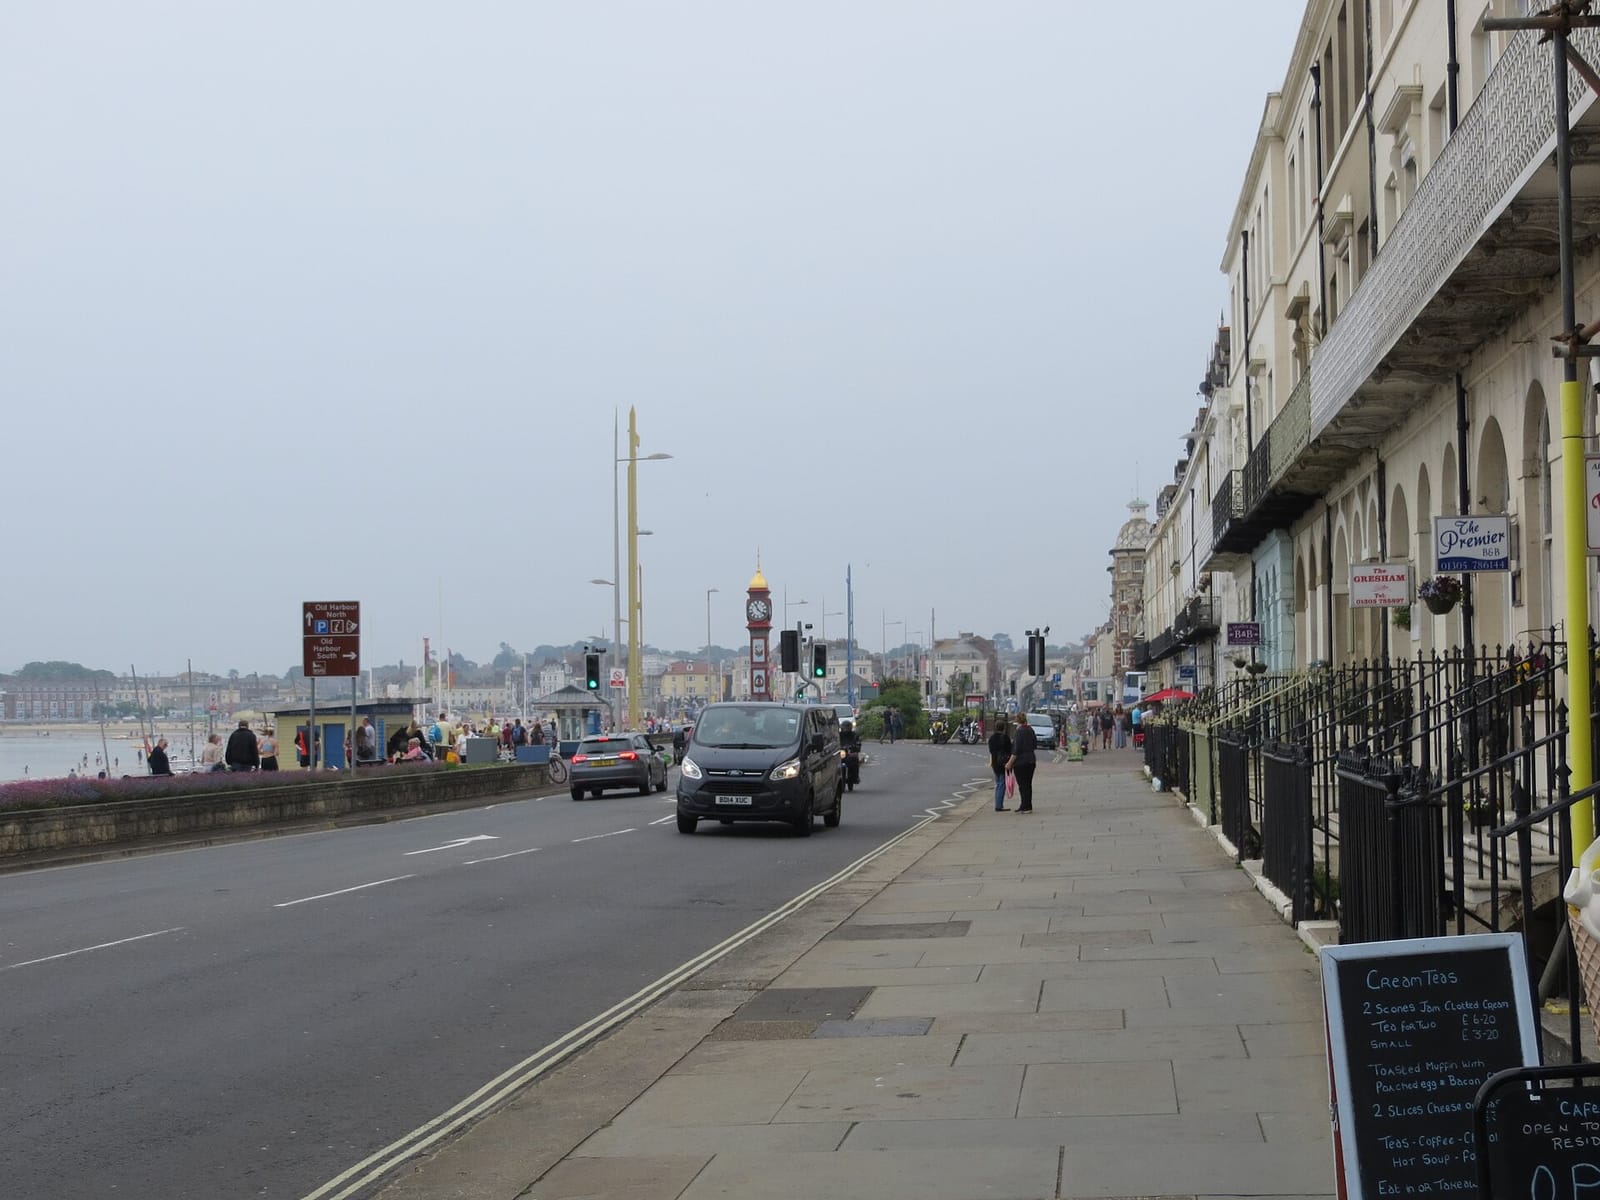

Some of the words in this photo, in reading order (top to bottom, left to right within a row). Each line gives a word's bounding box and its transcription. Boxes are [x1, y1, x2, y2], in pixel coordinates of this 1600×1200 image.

[1455, 520, 1479, 535] The
[1440, 530, 1505, 555] Premier
[1482, 548, 1500, 557] B&B
[1440, 561, 1468, 570] 01305
[1472, 560, 1505, 569] 786144
[1353, 574, 1405, 583] GRESHAM
[315, 603, 328, 611] Old
[329, 603, 358, 611] Harbour
[317, 621, 327, 633] P
[1234, 629, 1253, 639] B&B
[316, 652, 338, 660] South
[1421, 969, 1458, 986] Teas
[1362, 1001, 1372, 1015] 2
[1375, 1002, 1416, 1015] Scones
[1420, 1000, 1441, 1013] Jam
[1371, 1020, 1397, 1033] Tea
[1368, 1063, 1421, 1077] Toasted
[1425, 1062, 1459, 1073] Muffin
[1420, 1080, 1438, 1092] egg
[1448, 1074, 1481, 1087] Bacon
[1372, 1103, 1383, 1117] 2
[1427, 1102, 1462, 1114] Cheese
[1522, 1123, 1568, 1135] OPEN
[1580, 1121, 1600, 1131] TO
[1377, 1135, 1409, 1150] Teas
[1418, 1136, 1455, 1149] Coffee
[1422, 1153, 1450, 1166] Soup
[1378, 1179, 1401, 1195] Eat
